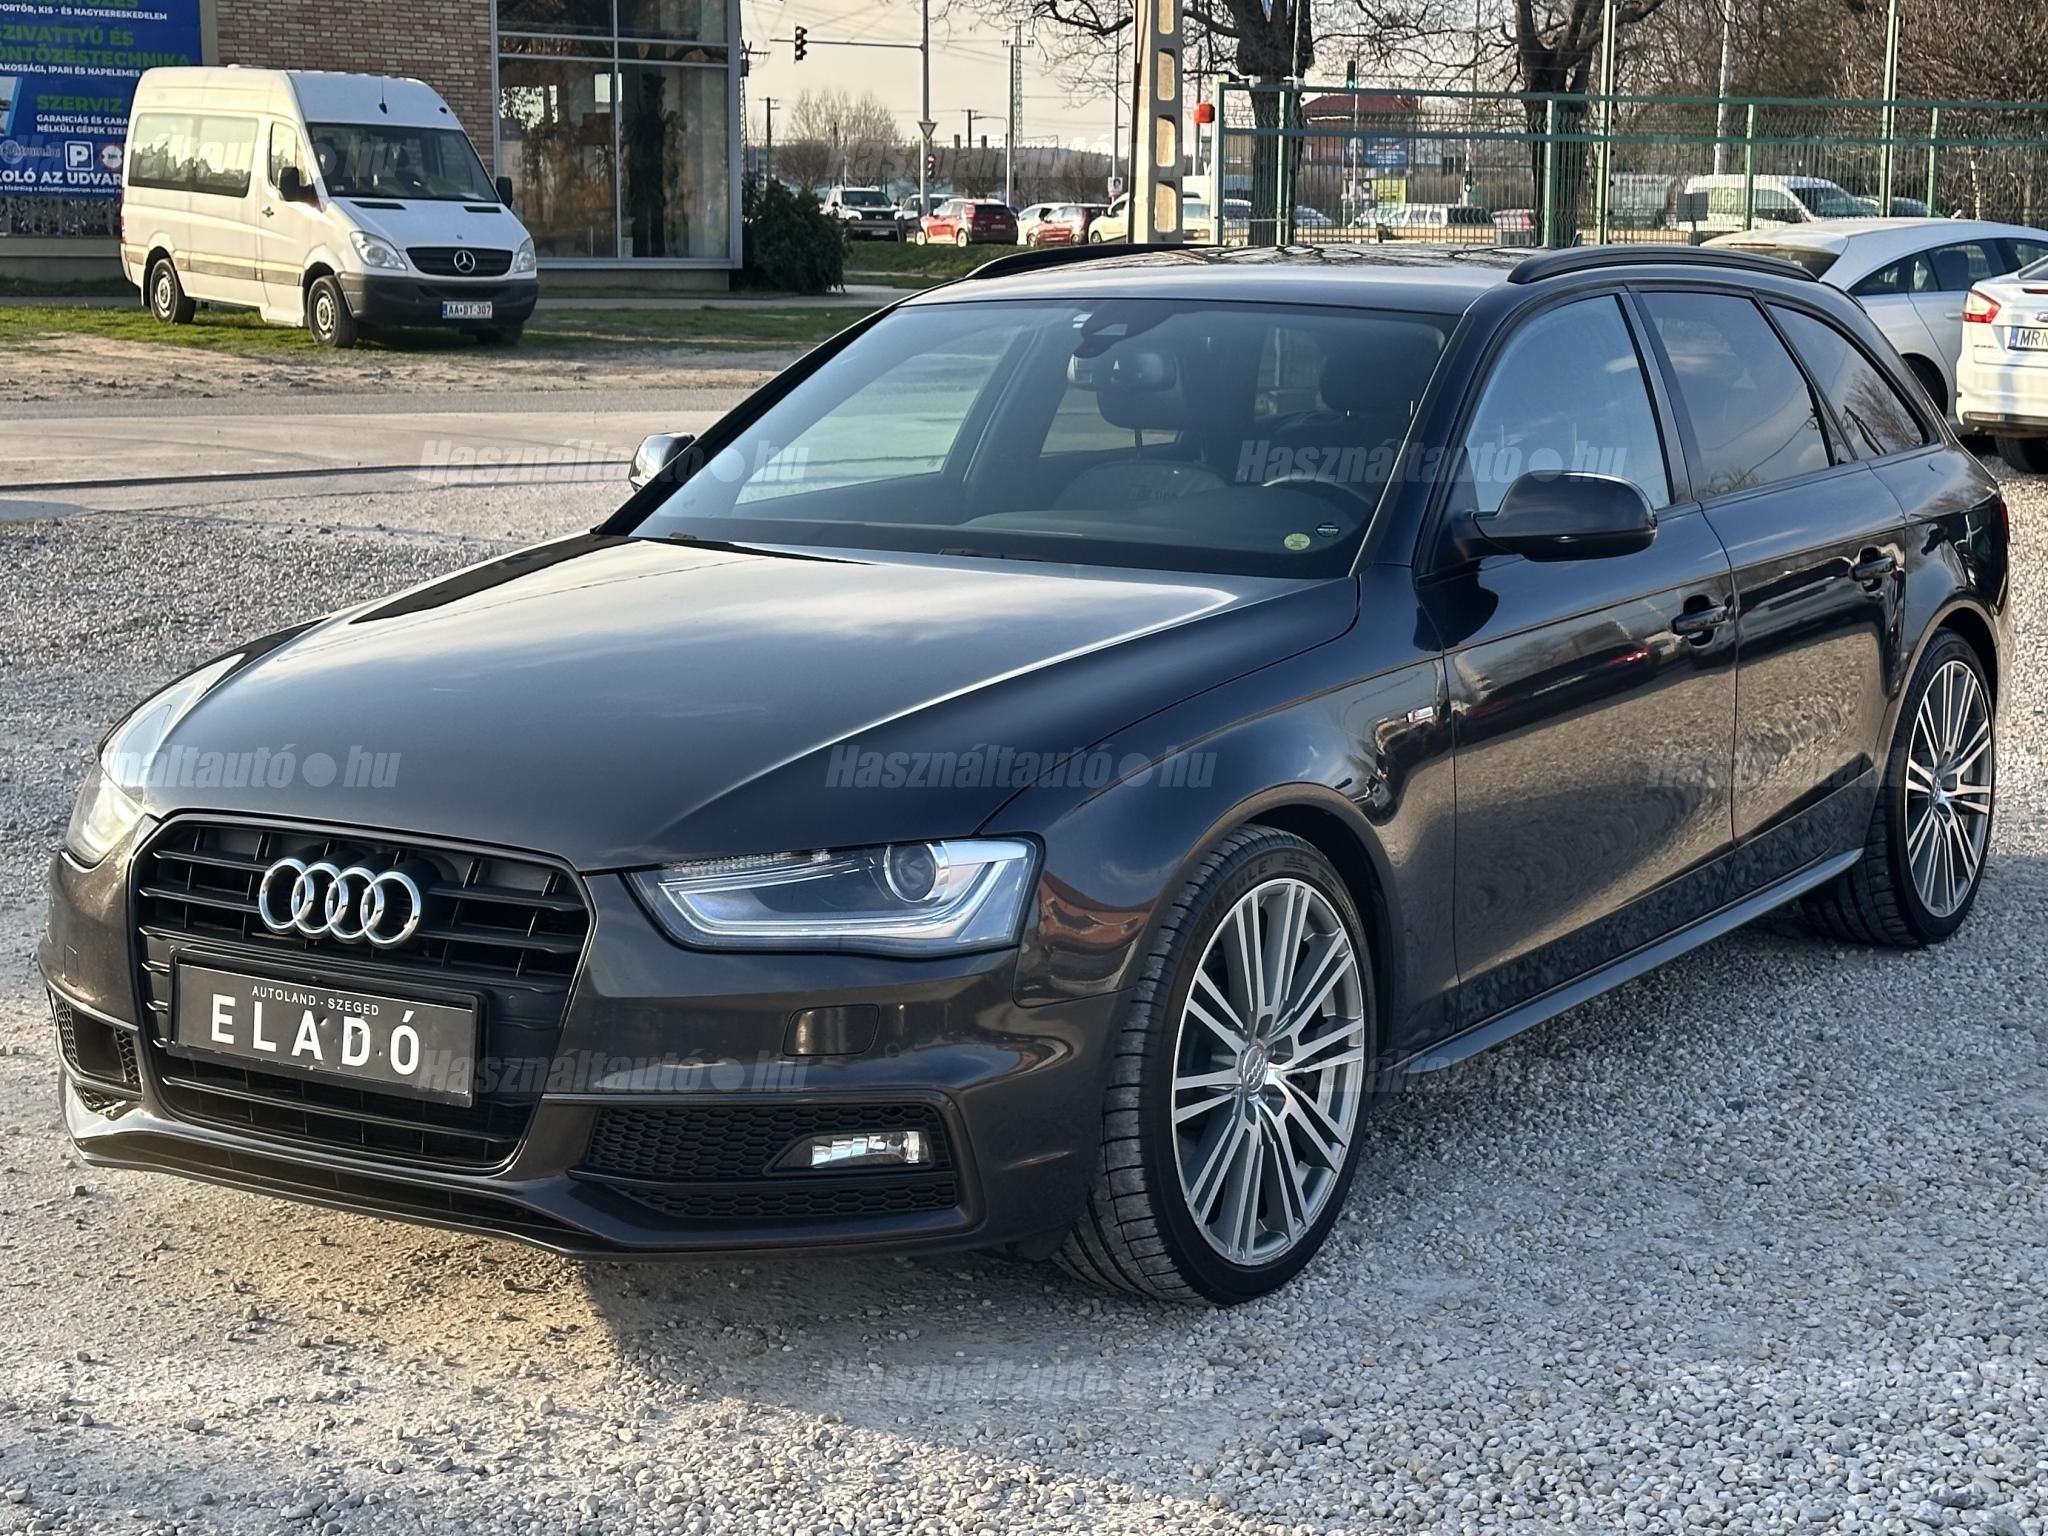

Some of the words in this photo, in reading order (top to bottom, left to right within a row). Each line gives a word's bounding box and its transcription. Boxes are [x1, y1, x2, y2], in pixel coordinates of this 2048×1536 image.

[38, 6, 53, 14] KIS
[60, 6, 72, 15] ÉS
[74, 8, 167, 20] NAGYKERESKEDELEM
[0, 23, 103, 45] ZIVATTYÚ
[109, 27, 134, 47] ÉS
[48, 65, 72, 74] IPARI
[74, 64, 86, 75] ÉS
[87, 67, 140, 78] NAPELEMES
[36, 94, 123, 113] SZERVIZ
[36, 114, 89, 124] GARANCIÁS
[91, 115, 102, 125] ÉS
[37, 123, 75, 133] NÉLKÜLI
[76, 124, 106, 134] GÉPEK
[0, 167, 36, 184] OLÓ
[40, 171, 63, 184] AZ
[252, 985, 316, 1006] AUTOLAND
[328, 998, 379, 1016] SZEGED
[211, 993, 421, 1076] ELADÓ
